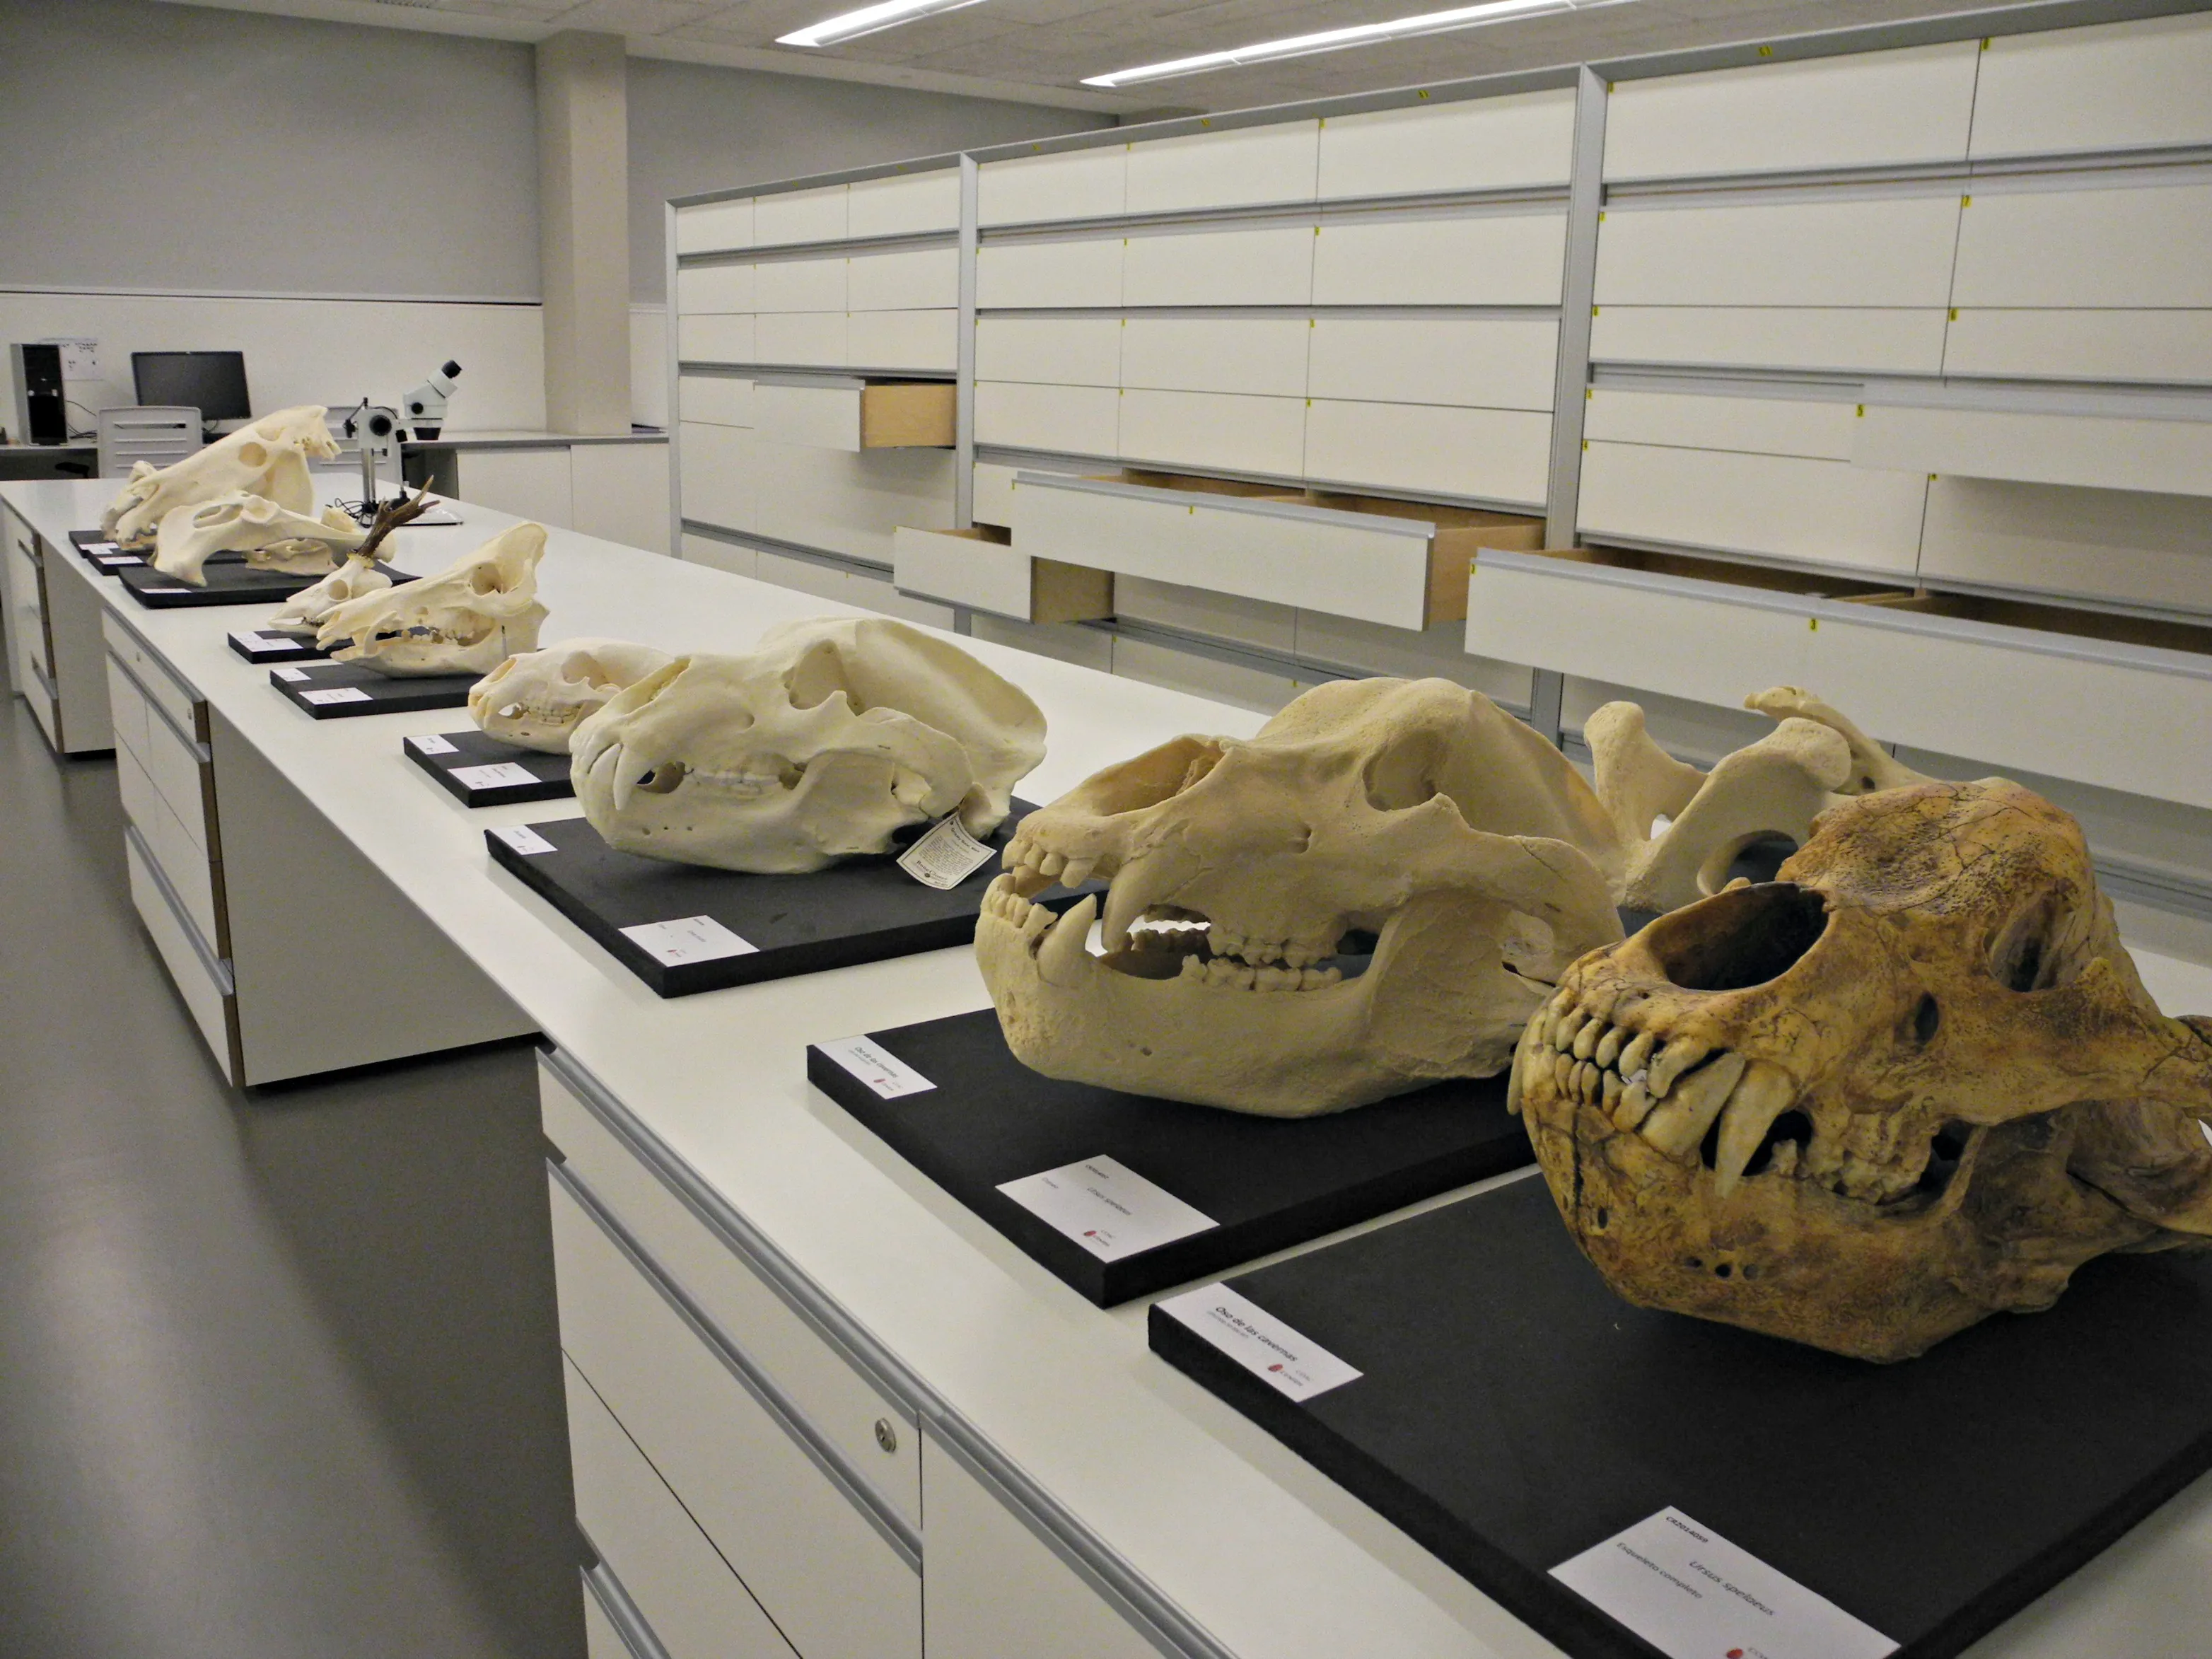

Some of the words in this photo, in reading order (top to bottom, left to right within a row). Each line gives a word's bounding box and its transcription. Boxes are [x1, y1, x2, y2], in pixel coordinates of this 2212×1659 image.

[1216, 1307, 1233, 1319] Oso
[1233, 1317, 1246, 1327] de
[1244, 1325, 1259, 1335] las
[1257, 1335, 1298, 1362] cavernas
[1666, 1516, 1709, 1543] CR2014059
[1617, 1542, 1660, 1571] Esqueleto
[1659, 1571, 1703, 1600] completo
[1689, 1561, 1723, 1583] Ursus
[1722, 1583, 1775, 1617] spelaeus
